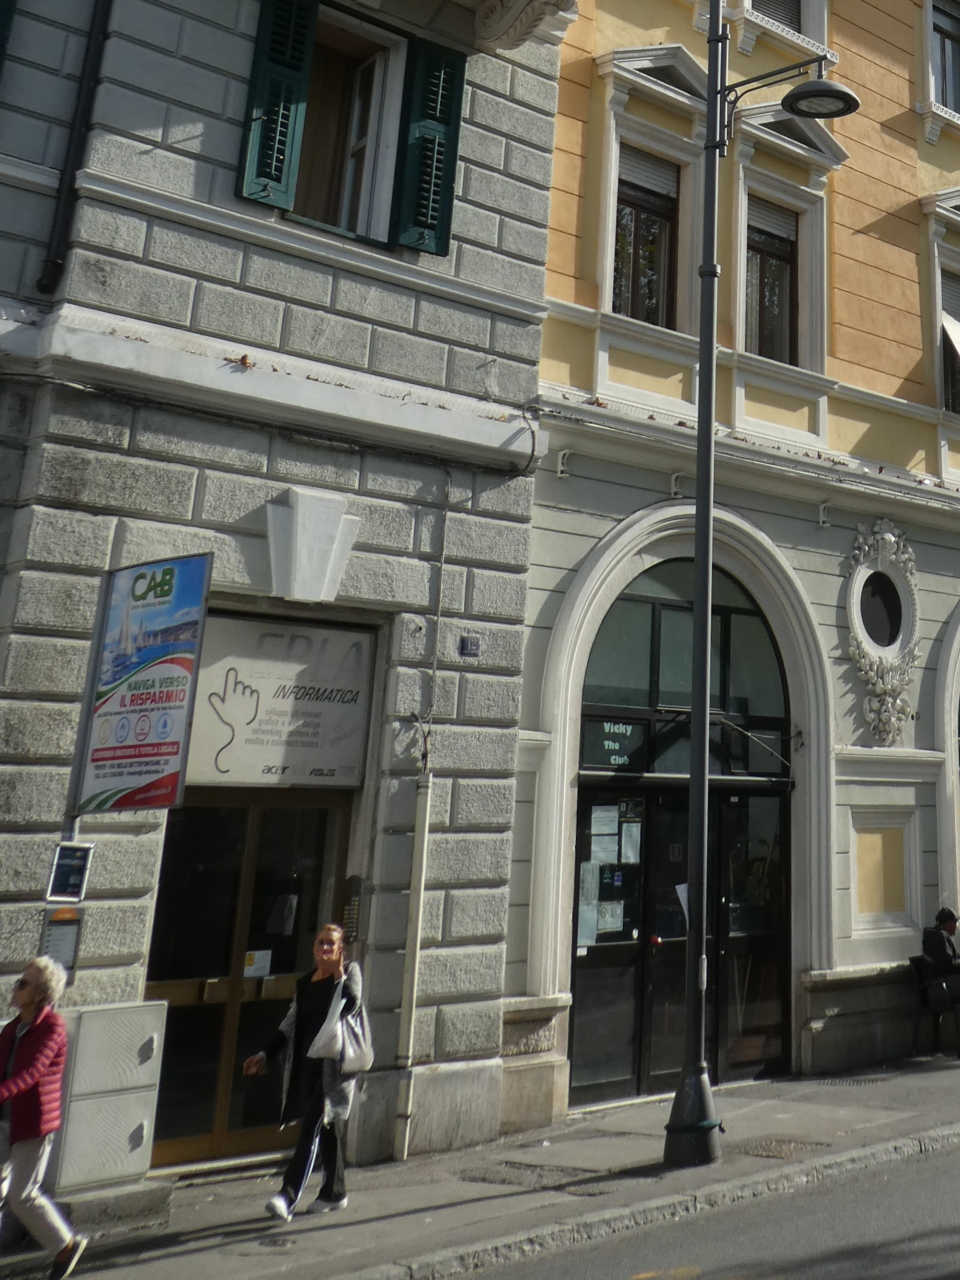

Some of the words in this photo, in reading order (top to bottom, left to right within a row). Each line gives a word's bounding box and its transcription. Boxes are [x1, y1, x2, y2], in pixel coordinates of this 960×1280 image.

[131, 567, 175, 602] CAB
[127, 678, 156, 692] NAVIGA
[159, 675, 188, 689] VERSO
[120, 694, 127, 708] IL
[129, 689, 186, 707] RISPARMIO
[272, 684, 360, 704] INFORMATICA
[603, 721, 632, 736] Vicky
[159, 744, 178, 753] LEGALE
[603, 740, 620, 750] The
[610, 755, 630, 765] Club
[262, 765, 290, 775] acer
[309, 768, 337, 778] ASUS
